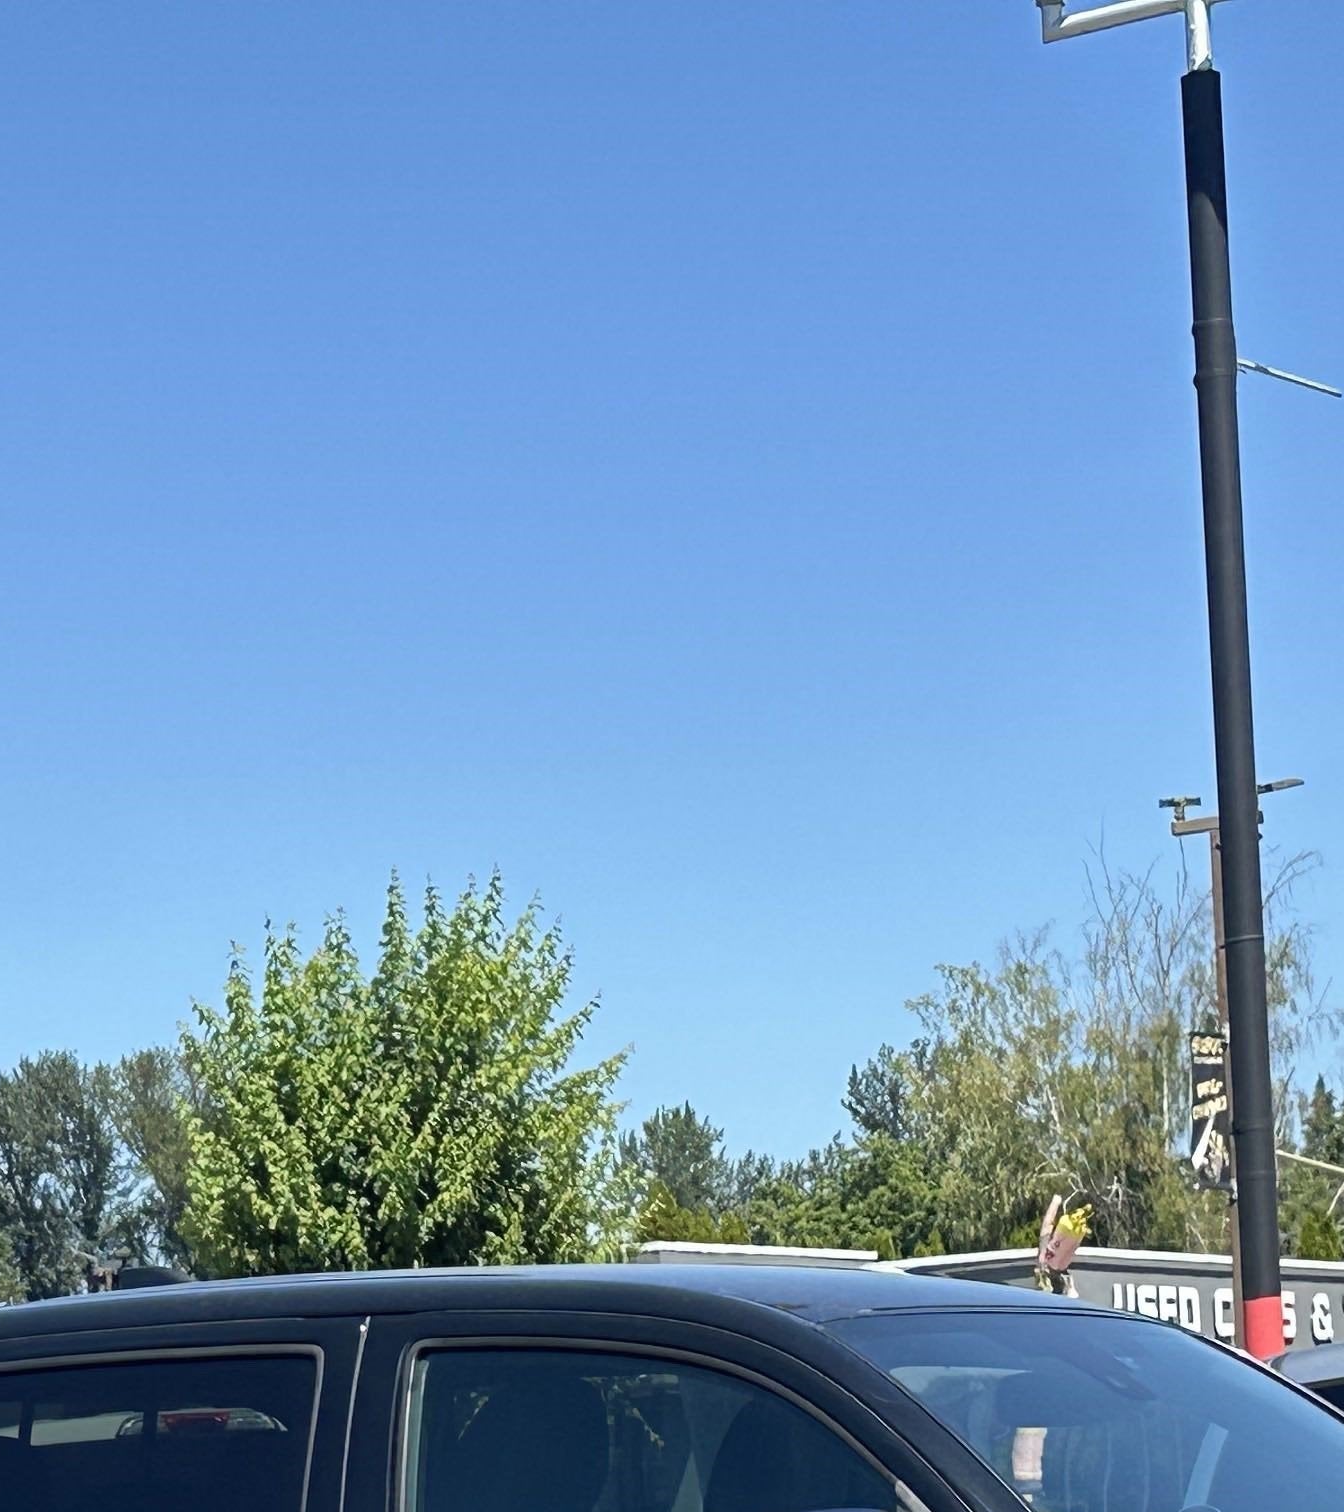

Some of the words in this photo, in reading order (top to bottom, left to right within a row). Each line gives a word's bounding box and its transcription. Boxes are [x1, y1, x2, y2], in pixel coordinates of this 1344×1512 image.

[1113, 1282, 1201, 1333] USED
[1214, 1287, 1297, 1340] CS
[1311, 1292, 1335, 1341] &
